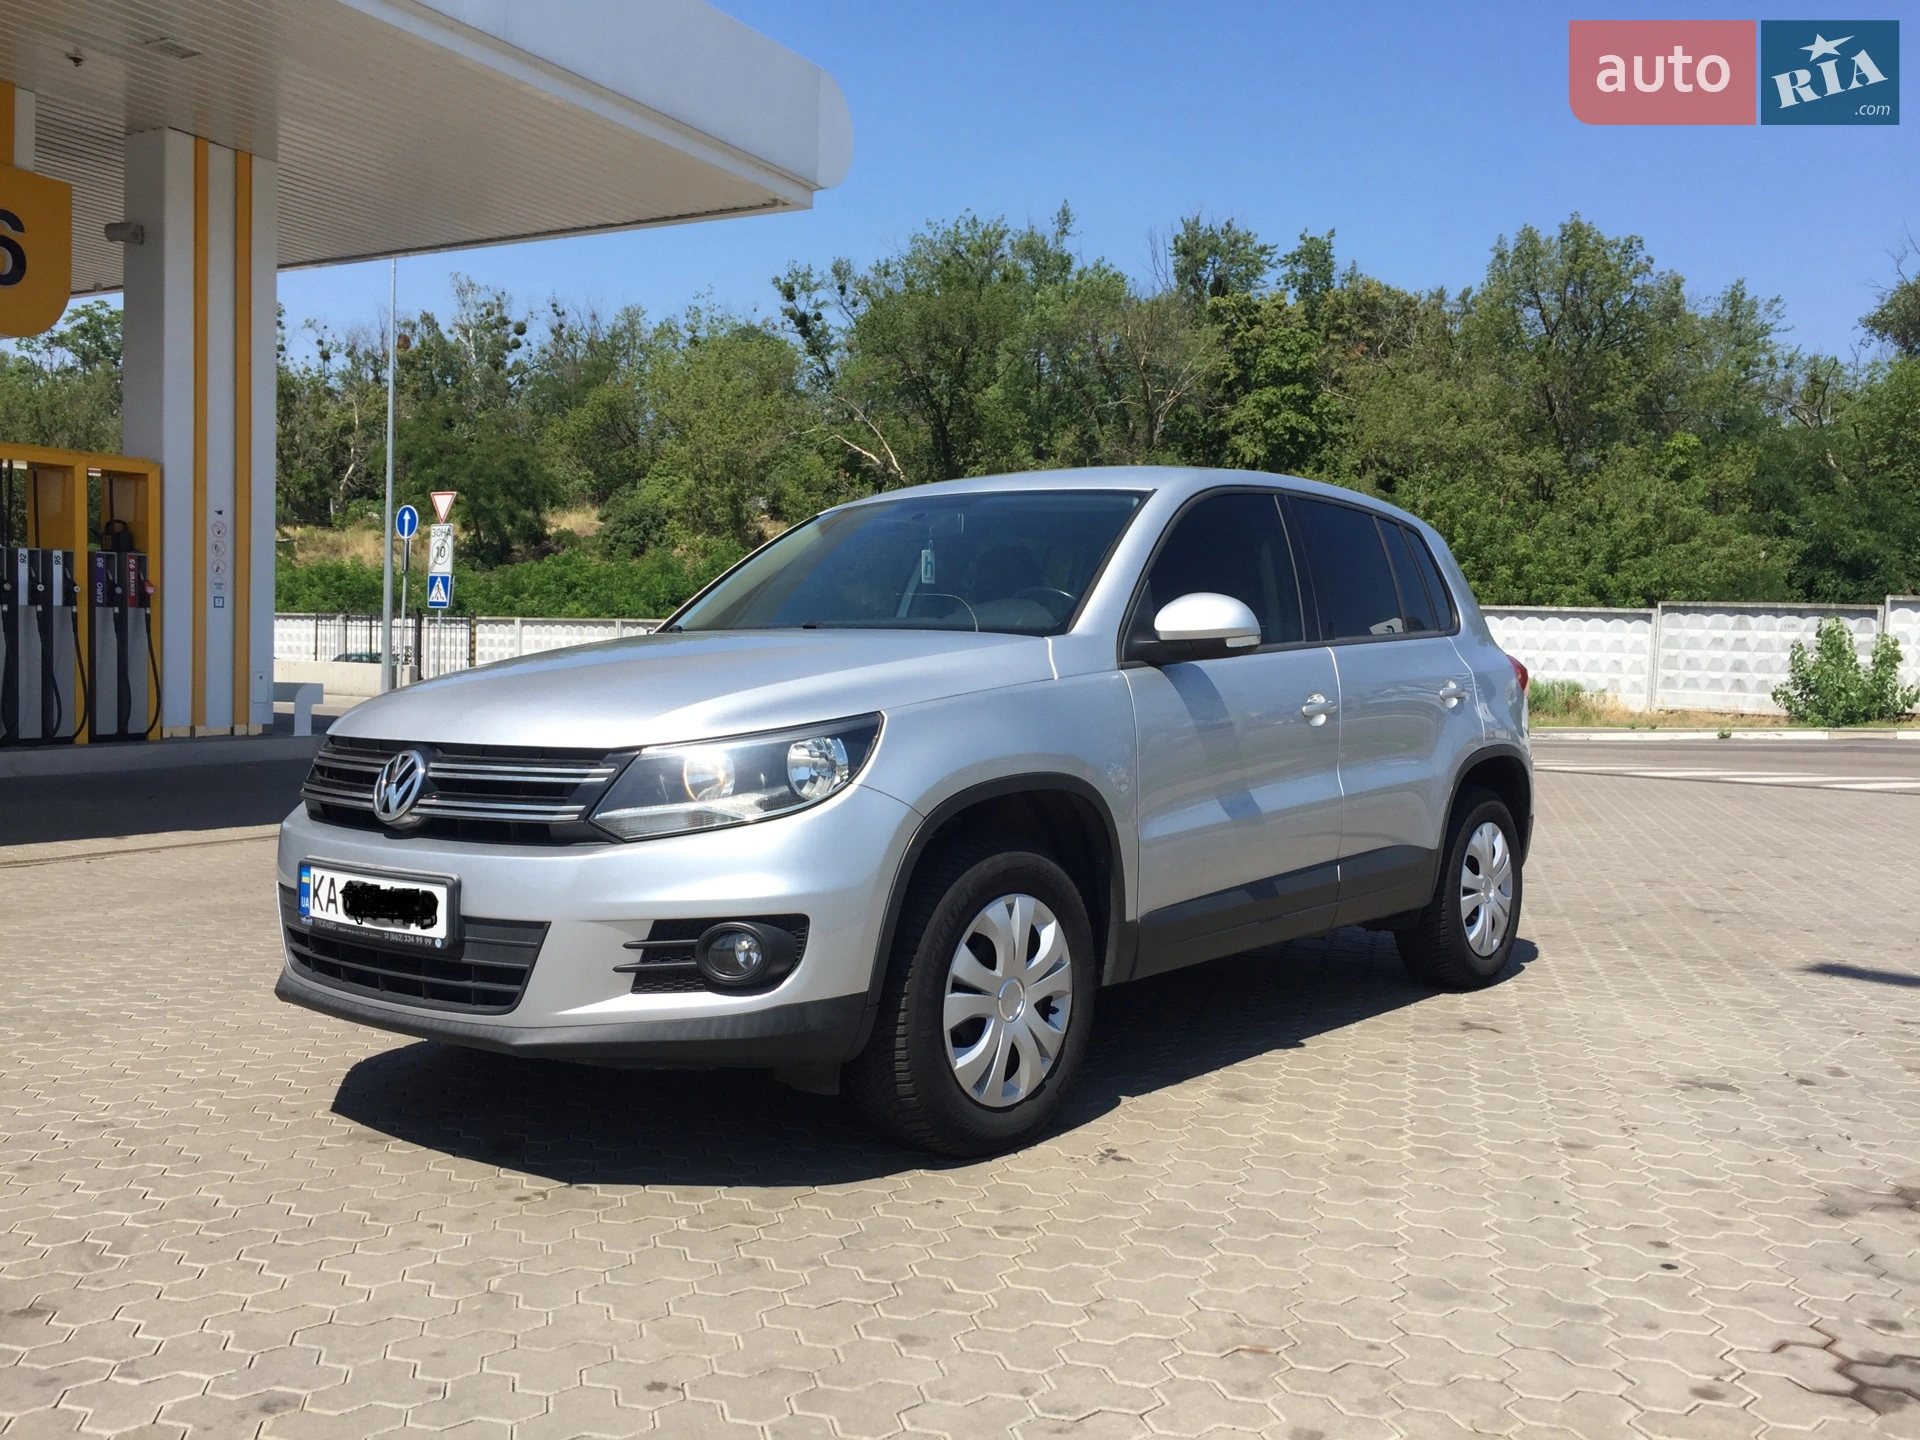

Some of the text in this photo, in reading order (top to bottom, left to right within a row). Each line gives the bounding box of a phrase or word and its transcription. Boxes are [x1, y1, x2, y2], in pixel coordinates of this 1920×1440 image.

[436, 545, 446, 558] 10
[20, 553, 27, 564] 92
[54, 555, 61, 565] 95
[97, 557, 104, 568] 95
[129, 558, 136, 569] 95
[312, 873, 339, 915] KA
[301, 897, 310, 909] UA
